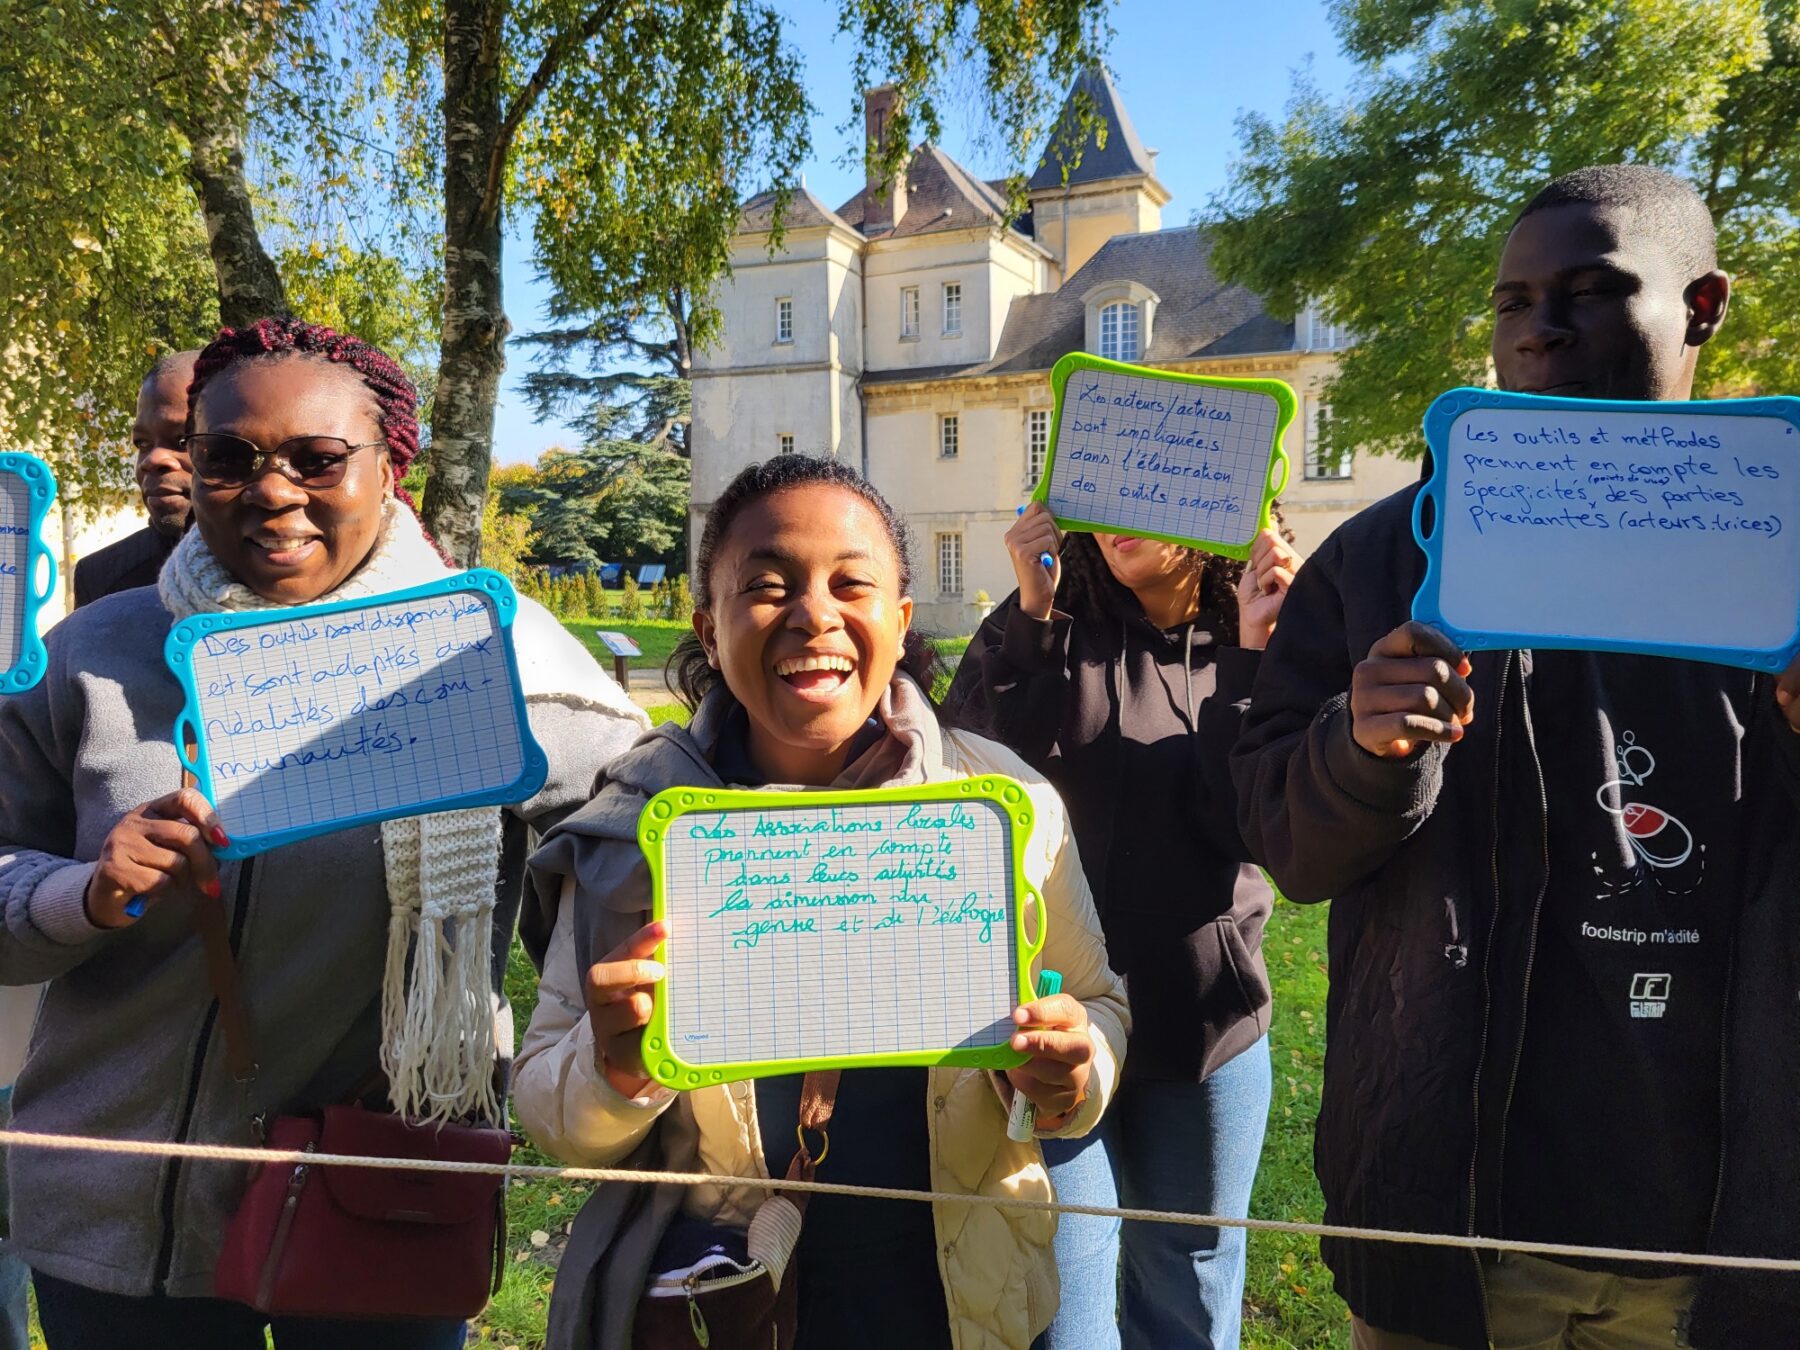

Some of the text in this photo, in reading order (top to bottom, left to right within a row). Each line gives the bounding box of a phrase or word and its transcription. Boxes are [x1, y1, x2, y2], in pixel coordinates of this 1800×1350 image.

[1072, 418, 1107, 432] sont
[1513, 428, 1581, 445] outils
[1590, 428, 1609, 444] et
[1622, 427, 1721, 448] méthodes
[1070, 448, 1232, 483] dans l'élaboration
[1463, 453, 1780, 483] prennent en compte les
[1071, 476, 1240, 520] des outils adaptés
[1605, 484, 1648, 504] des
[1660, 487, 1745, 509] parties
[203, 596, 487, 656] Des outils sont disponibles
[208, 636, 493, 697] et sont adaptés aux
[351, 686, 408, 715] des
[897, 803, 976, 831] locales
[705, 832, 952, 884] prennent en compte
[725, 862, 791, 887] dans
[807, 862, 860, 884] leurs
[763, 891, 877, 913] dimension
[889, 882, 932, 904] du
[732, 917, 818, 949] genre
[835, 914, 864, 932] et
[874, 907, 904, 929] de
[1581, 921, 1647, 946] foolstrip
